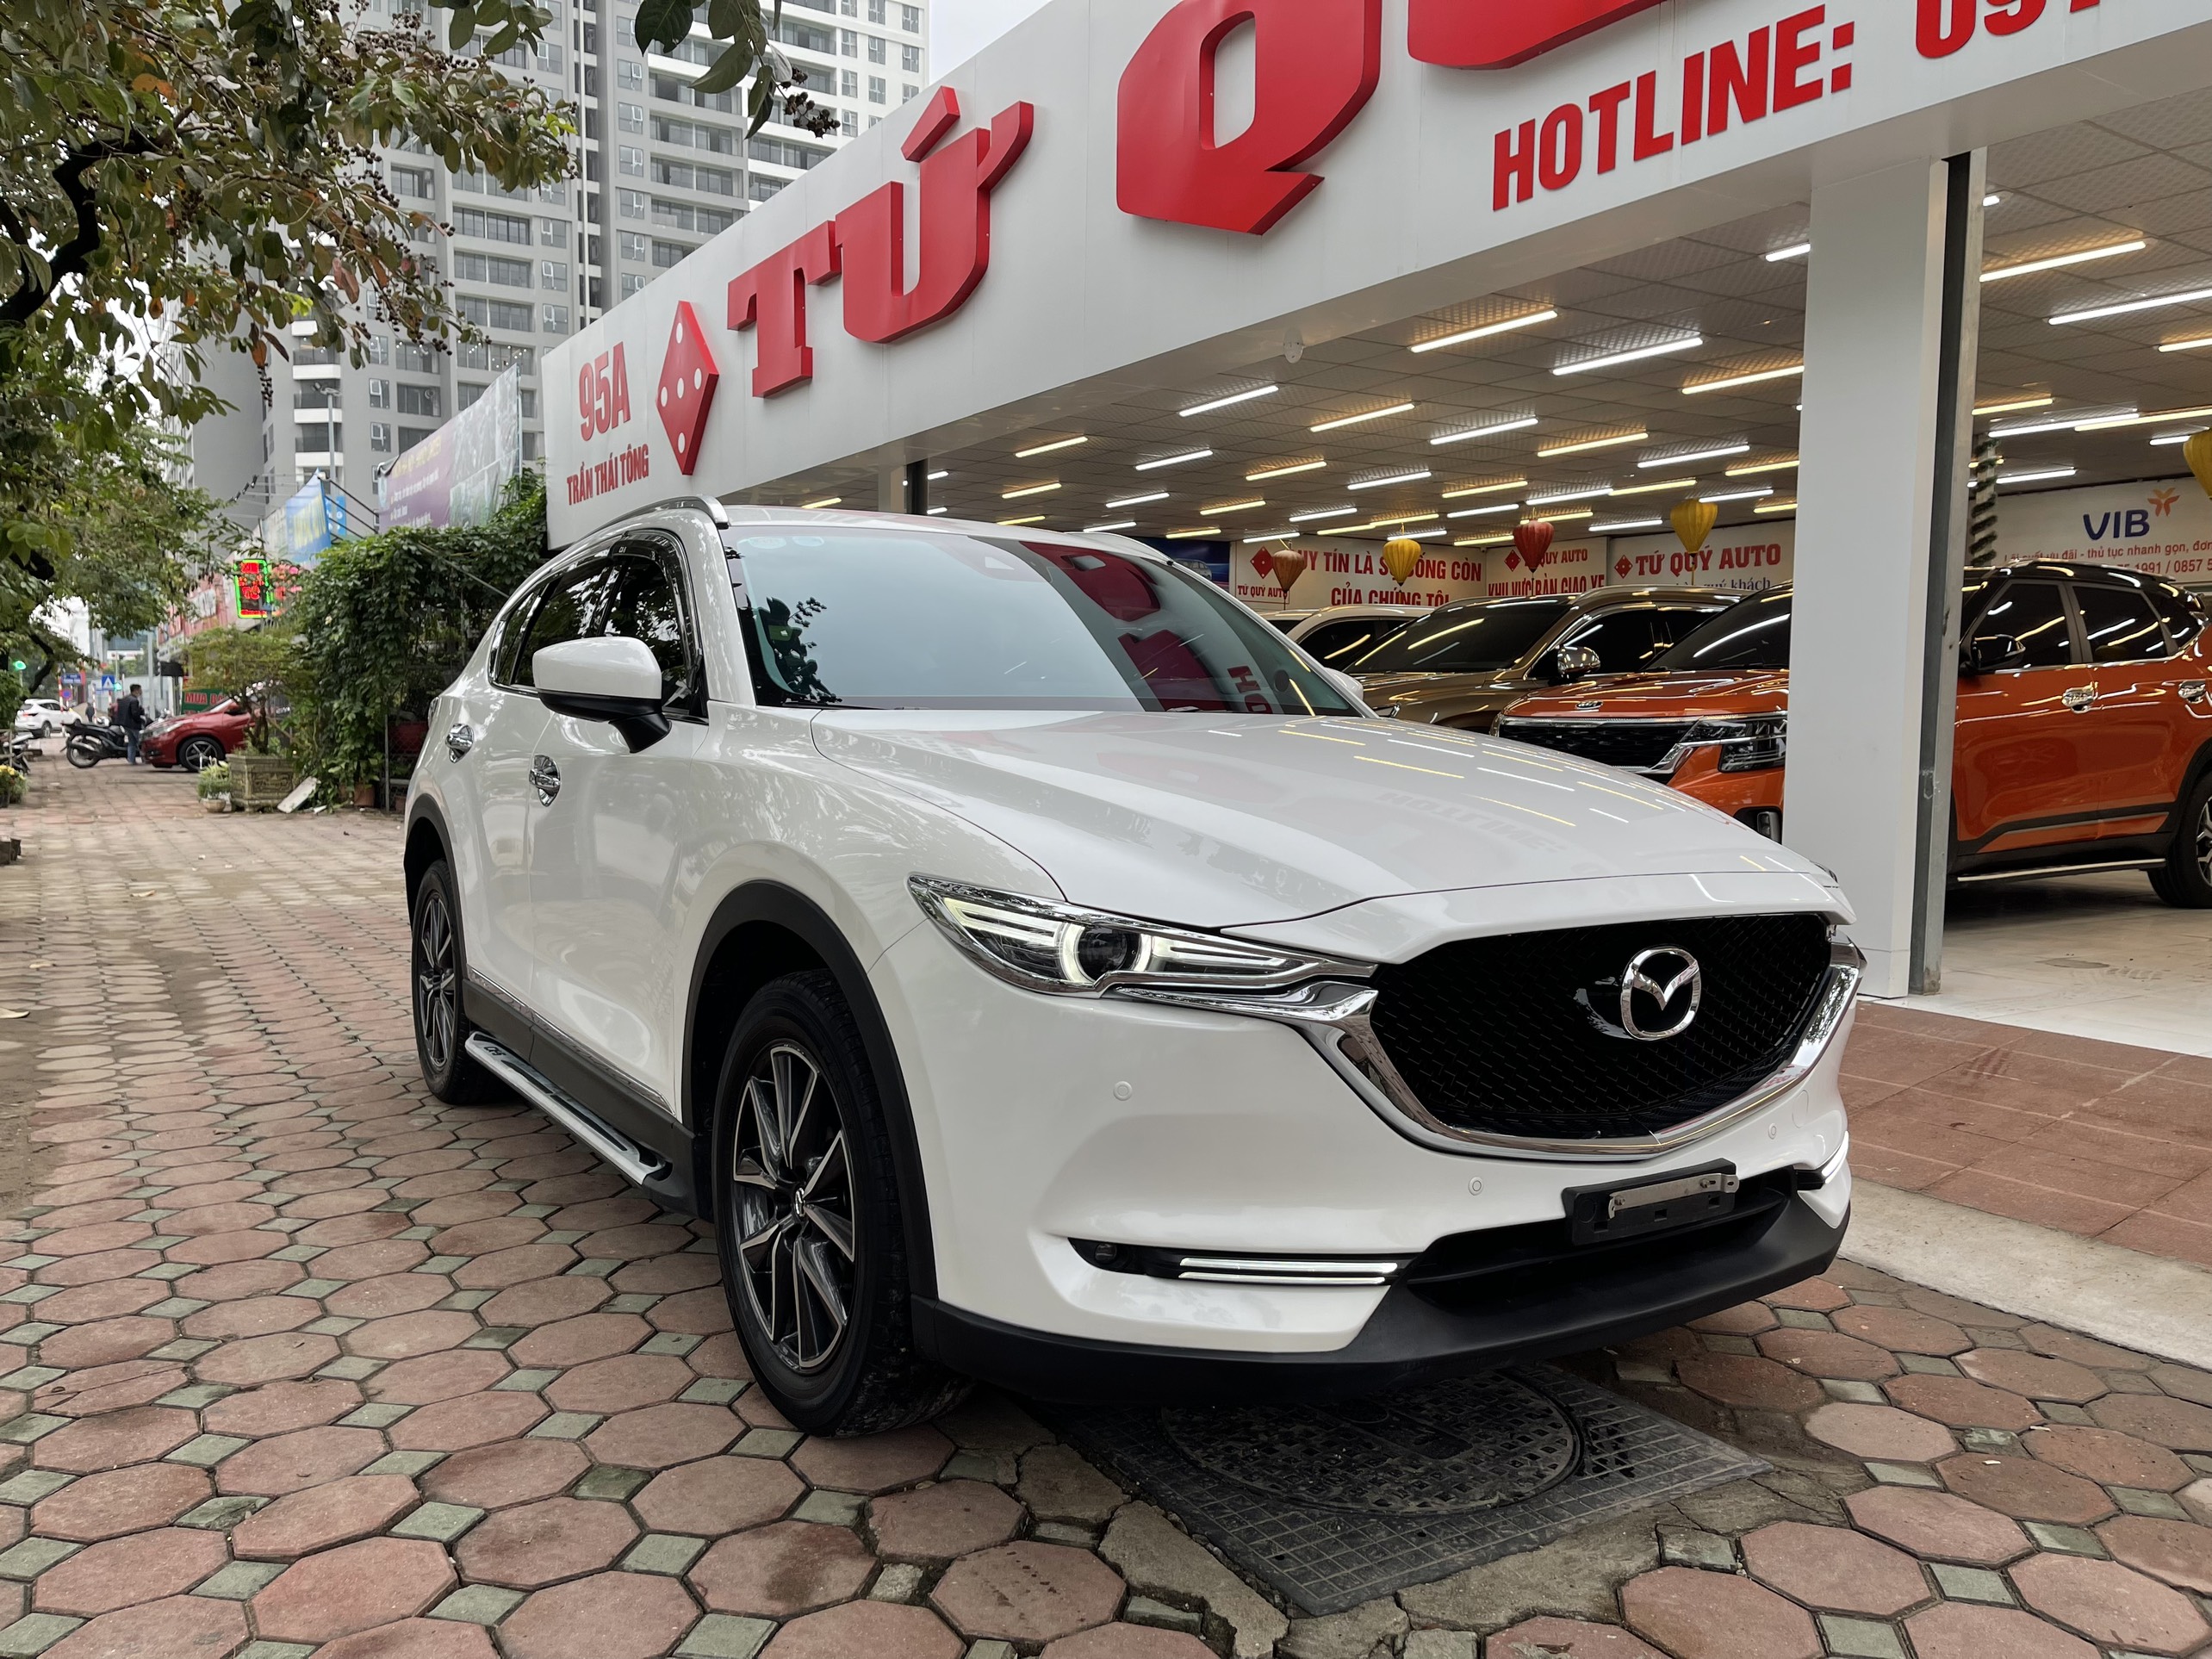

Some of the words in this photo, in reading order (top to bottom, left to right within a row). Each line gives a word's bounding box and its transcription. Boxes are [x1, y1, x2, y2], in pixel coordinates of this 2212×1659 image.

[1493, 3, 1855, 212] HOTLINE:
[727, 86, 1034, 398] TỨ
[579, 341, 631, 442] 95A
[594, 452, 618, 496] THÁI
[619, 443, 649, 485] TÔNG
[2083, 509, 2150, 541] VIB
[1323, 549, 1350, 573] TÍN
[1354, 551, 1374, 575] LÀ
[1451, 557, 1482, 581] CÒN
[1561, 549, 1588, 563] AUTO
[1636, 550, 1665, 576] TỨ
[1670, 545, 1713, 578] QUÝ
[1718, 544, 1781, 570] AUTO
[2128, 544, 2161, 556] nhanh
[2174, 558, 2203, 573] 0857
[1331, 581, 1363, 606] CỦA
[184, 692, 208, 705] MUA
